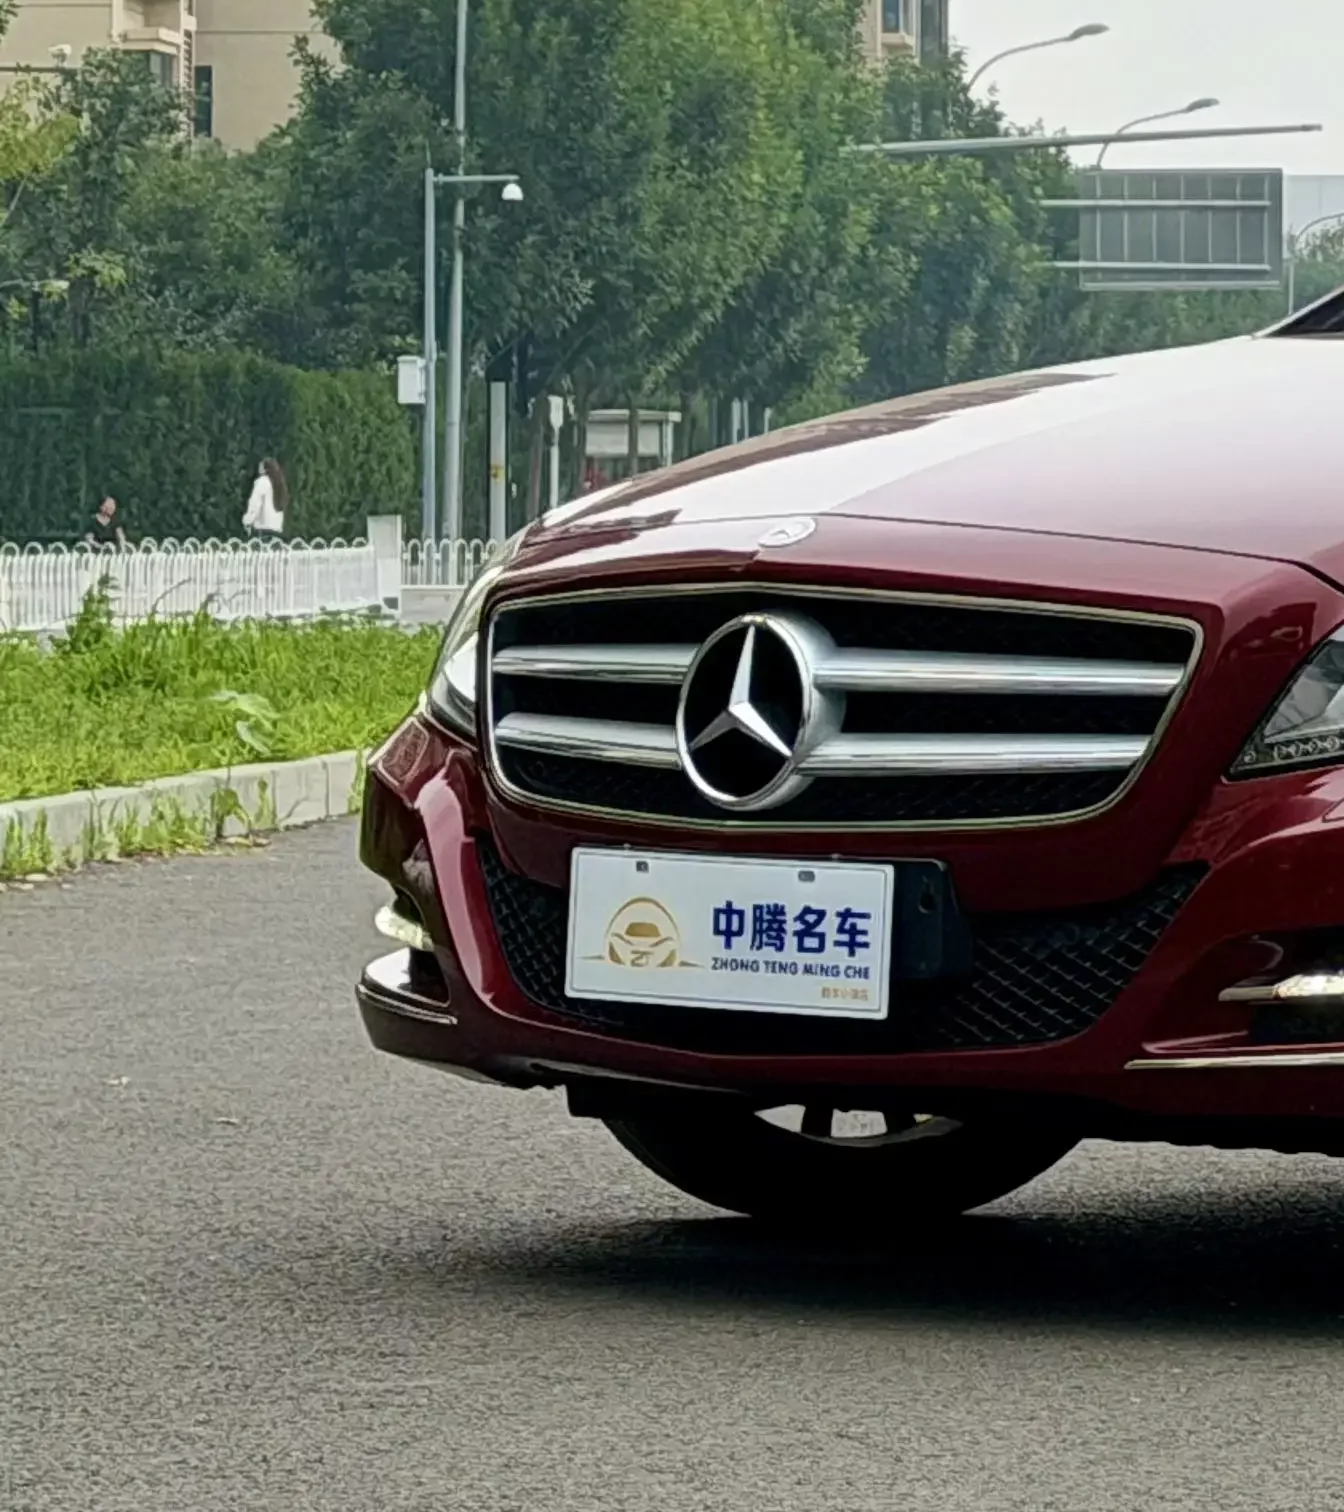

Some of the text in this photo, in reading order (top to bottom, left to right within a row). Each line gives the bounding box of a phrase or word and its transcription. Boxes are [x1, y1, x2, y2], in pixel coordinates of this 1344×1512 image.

[713, 900, 871, 957] 中腾名车
[711, 957, 760, 973] ZHONG
[763, 959, 798, 975] TENG
[843, 965, 870, 980] CHE
